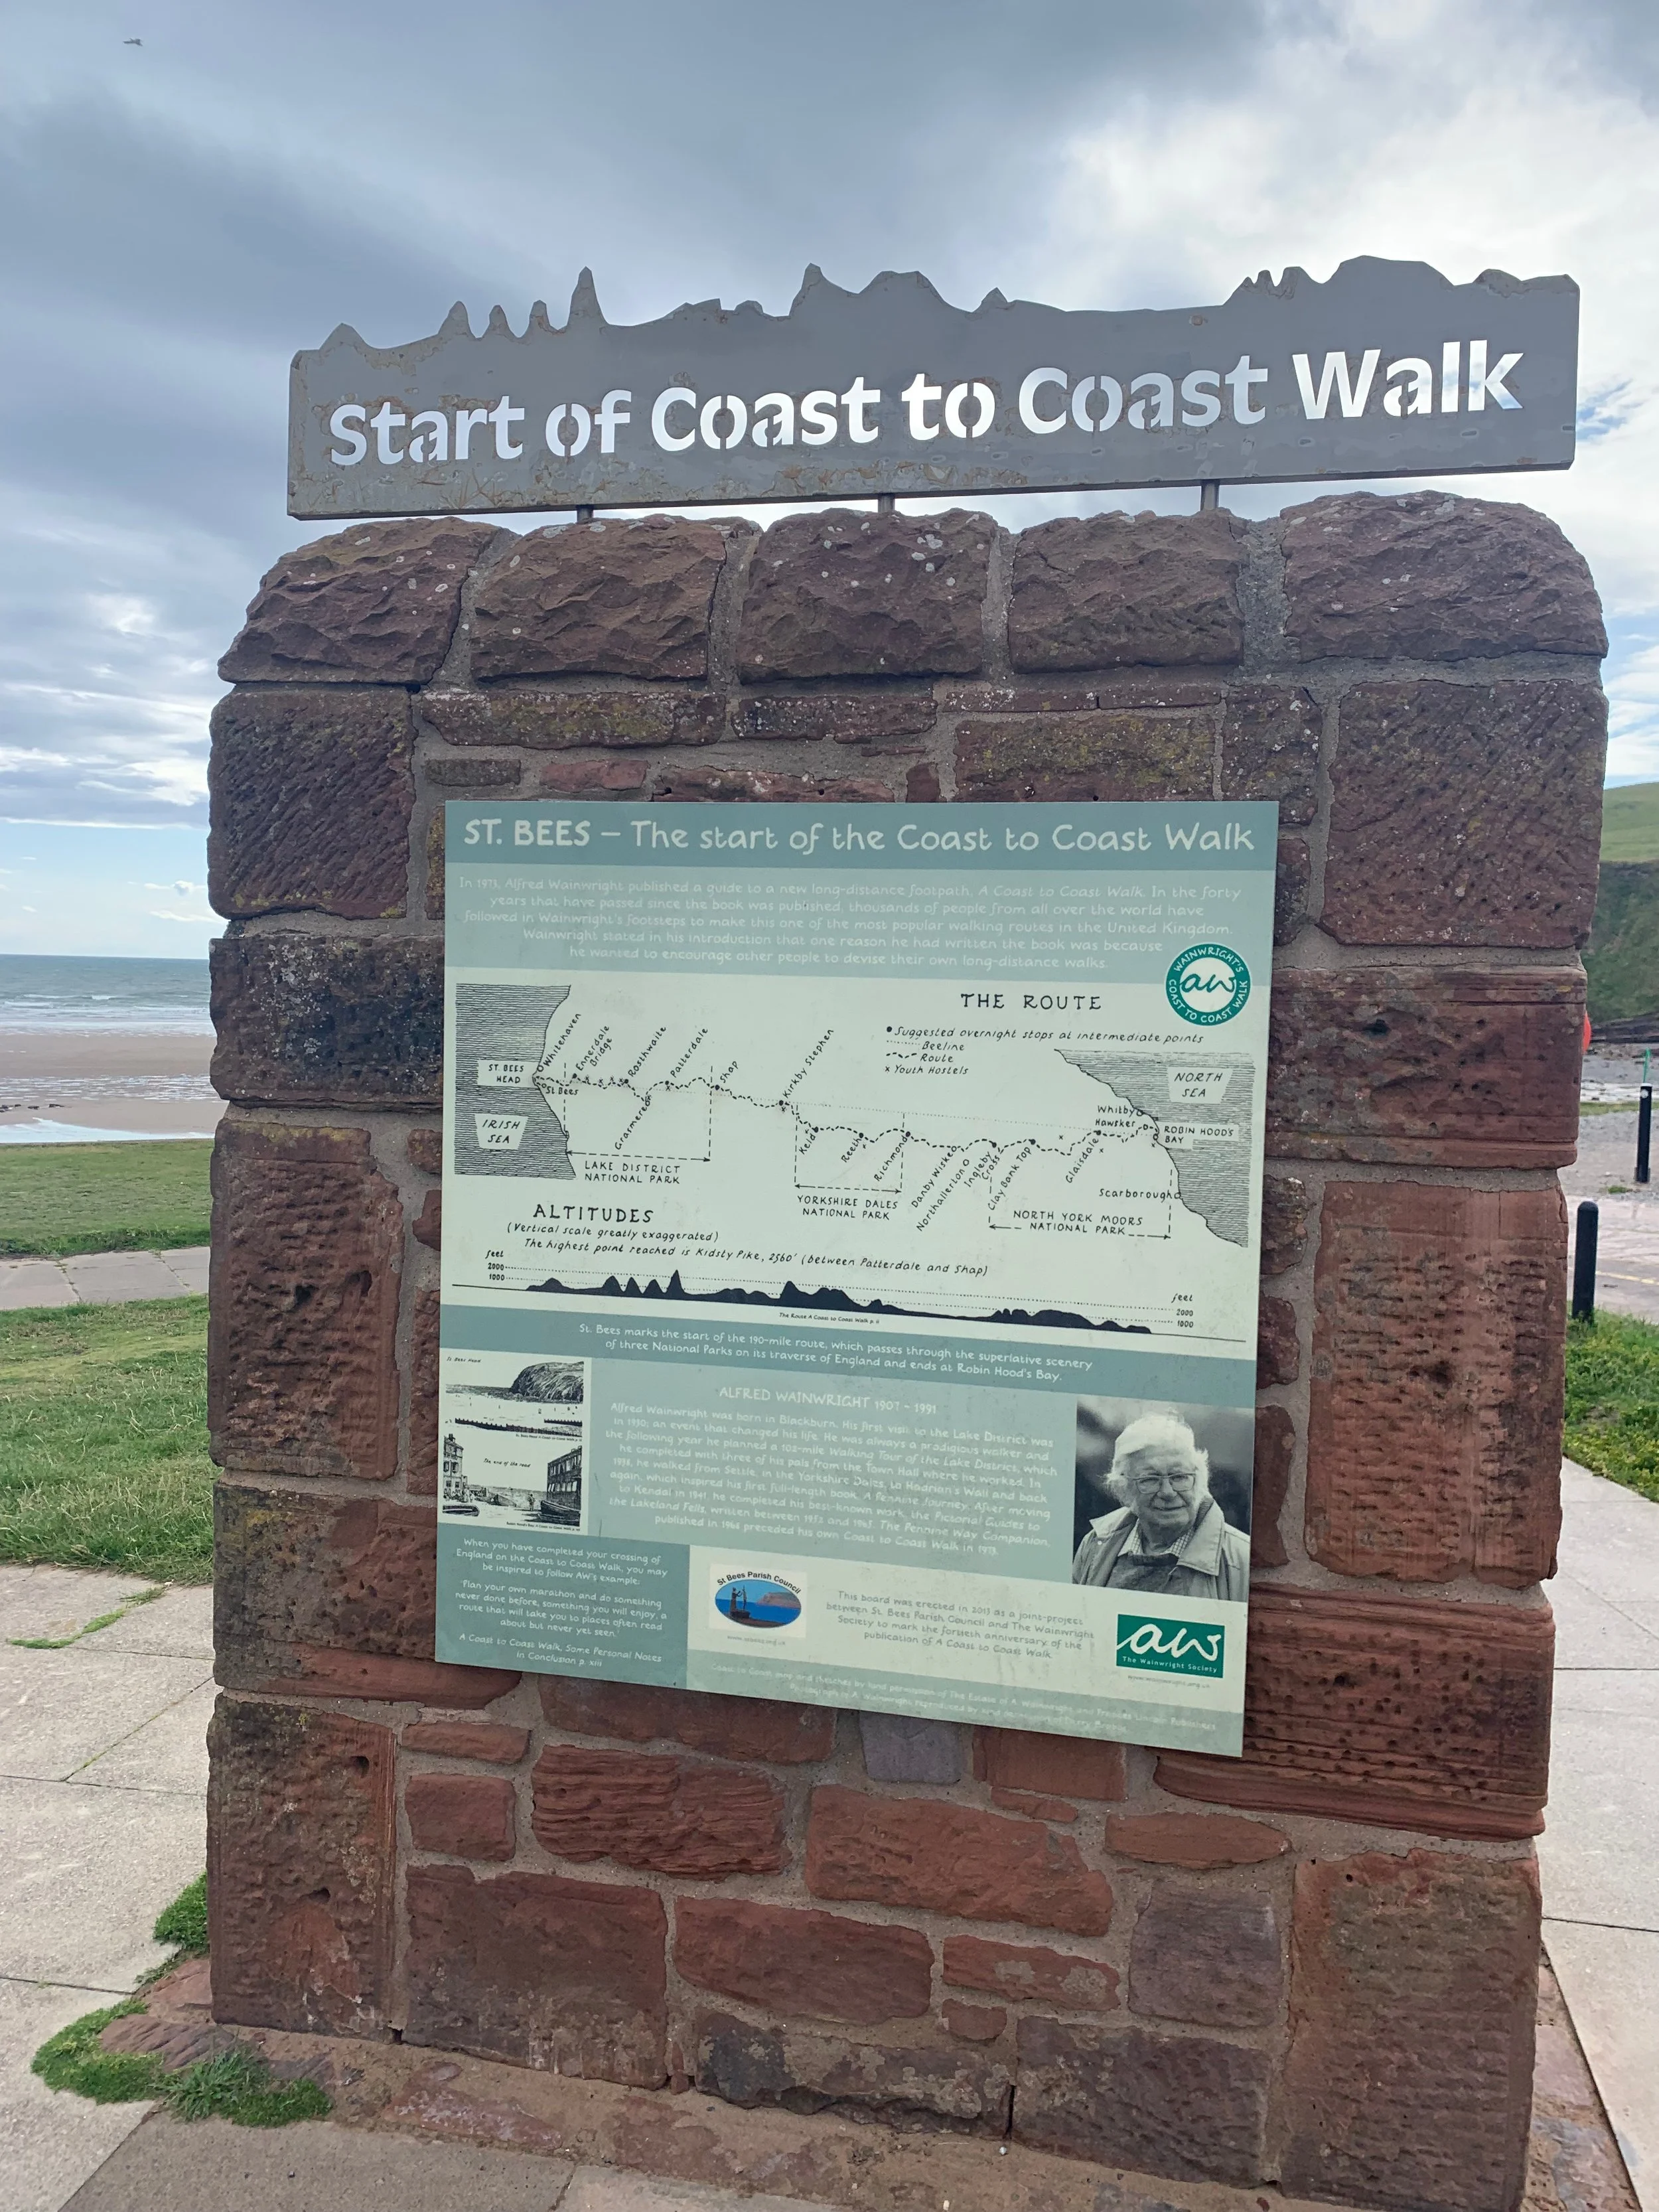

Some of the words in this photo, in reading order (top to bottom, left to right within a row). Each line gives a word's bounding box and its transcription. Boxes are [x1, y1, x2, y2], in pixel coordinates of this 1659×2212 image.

[328, 394, 526, 467] Start
[544, 389, 632, 457] of
[650, 376, 881, 451] Coast
[901, 372, 995, 441] to
[1019, 354, 1269, 436] Coast
[1293, 339, 1525, 421] Walk
[463, 818, 503, 846] ST.
[514, 820, 591, 847] BEES
[630, 820, 689, 848] The
[699, 825, 778, 850] start
[789, 823, 824, 855] of
[831, 823, 885, 850] the
[898, 823, 993, 851] Coast
[1005, 827, 1039, 851] to
[1052, 823, 1151, 851] Coast
[1165, 822, 1255, 851] Walk
[1174, 946, 1244, 972] WAINWRIGHT'S
[961, 994, 1005, 1009] THE
[1024, 995, 1102, 1010] ROUTE
[1169, 980, 1185, 1009] COAST
[1185, 1009, 1197, 1020] TO
[1200, 1007, 1232, 1023] COAST
[1232, 980, 1248, 1008] WALK
[544, 1013, 581, 1067] Whitehaven
[895, 1026, 954, 1040] Suggested
[960, 1029, 1017, 1041] overnight
[1023, 1031, 1054, 1041] stops
[1077, 1032, 1161, 1043] intermediate
[1163, 1033, 1204, 1044] points
[575, 1025, 610, 1071] Ennerdale
[590, 1037, 613, 1067] Bridge
[628, 1026, 666, 1077] Rosthwaite
[670, 1028, 708, 1078] Patterdale
[922, 1041, 964, 1051] Beeline
[488, 1064, 500, 1072] ST.
[503, 1064, 525, 1072] BEES
[782, 1067, 807, 1098] Kirkby
[806, 1029, 834, 1066] Stephen
[920, 1054, 954, 1063] Route
[720, 1061, 739, 1084] Shap
[895, 1065, 923, 1074] Youth
[928, 1066, 970, 1075] Hostels
[1174, 1072, 1224, 1082] NORTH
[545, 1086, 556, 1094] St
[558, 1086, 579, 1095] Bees
[1181, 1088, 1206, 1098] SEA
[1097, 1105, 1135, 1118] Whitby
[482, 1119, 520, 1130] IRISH
[614, 1106, 648, 1150] Grasmere
[1095, 1118, 1136, 1128] Hawsker
[1164, 1126, 1195, 1135] ROBIN
[1200, 1128, 1235, 1138] HOOD'S
[488, 1134, 510, 1143] SEA
[800, 1134, 816, 1155] Keld
[841, 1138, 861, 1163] Reeth
[874, 1136, 908, 1182] Richmond
[1066, 1138, 1099, 1184] Glaisdale
[585, 1161, 613, 1171] LAKE
[623, 1162, 680, 1173] DISTRICT
[964, 1151, 994, 1188] Ingleby
[981, 1153, 1001, 1180] Cross
[585, 1173, 642, 1183] NATIONAL
[649, 1175, 680, 1184] PARK
[911, 1179, 934, 1208] Danby
[932, 1151, 954, 1179] Wiske
[987, 1187, 1005, 1211] Clay
[999, 1163, 1019, 1192] Bank
[1015, 1146, 1032, 1168] Top
[797, 1195, 858, 1207] YORKSHIRE
[865, 1198, 898, 1209] DALES
[916, 1166, 964, 1232] Northallerton
[1099, 1188, 1173, 1200] Scarborough
[533, 1205, 654, 1223] ALTITUDES
[802, 1208, 855, 1218] NATIONAL
[862, 1210, 890, 1220] PARK
[1013, 1210, 1054, 1220] NORTH
[1062, 1213, 1092, 1222] YORK
[1102, 1215, 1143, 1226] MOORS
[506, 1222, 559, 1236] (Vertical
[563, 1225, 593, 1236] scale
[597, 1228, 638, 1240] greatly
[641, 1230, 719, 1244] exaggerated)
[1030, 1222, 1088, 1234] NATIONAL
[1096, 1224, 1126, 1236] PARK
[485, 1250, 504, 1260] feet
[524, 1238, 544, 1249] The
[545, 1240, 590, 1253] highest
[594, 1244, 625, 1256] point
[630, 1246, 676, 1256] reached
[681, 1248, 689, 1257] is
[695, 1248, 733, 1260] Kidsty
[735, 1250, 764, 1262] Pike,
[801, 1254, 855, 1268] (between
[860, 1258, 921, 1270] Patterdale
[926, 1264, 950, 1273] and
[953, 1264, 988, 1278] Shap)
[1177, 1319, 1192, 1328] 1000
[579, 1323, 592, 1334] St.
[596, 1324, 621, 1335] Bees
[624, 1327, 658, 1338] marks
[662, 1329, 680, 1339] the
[682, 1331, 710, 1341] start
[713, 1331, 725, 1343] of
[727, 1333, 746, 1343] the
[749, 1335, 792, 1346] 190-mile
[796, 1338, 828, 1349] route,
[831, 1340, 863, 1352] which
[867, 1344, 902, 1355] passes
[906, 1345, 952, 1361] through
[955, 1349, 975, 1360] the
[978, 1351, 1042, 1365] superlative
[1045, 1357, 1093, 1371] scenery
[605, 1339, 617, 1351] of
[620, 1340, 648, 1351] three
[652, 1341, 699, 1354] National
[703, 1345, 733, 1356] Parks
[736, 1349, 749, 1357] on
[753, 1349, 766, 1359] its
[769, 1351, 817, 1362] traverse
[820, 1353, 832, 1364] of
[835, 1354, 881, 1368] England
[883, 1357, 906, 1368] and
[910, 1360, 937, 1371] ends
[940, 1363, 954, 1372] at
[957, 1363, 991, 1375] Robin
[995, 1366, 1032, 1378] Hood's
[1036, 1370, 1062, 1383] Bay.
[719, 1386, 771, 1401] ALFRED
[775, 1391, 871, 1408] WAINWRIGHT
[874, 1400, 900, 1411] 1907
[913, 1402, 937, 1415] 1991
[463, 1538, 489, 1548] When
[491, 1542, 509, 1554] you
[511, 1542, 534, 1552] have
[536, 1546, 583, 1557] completed
[587, 1550, 607, 1560] your
[610, 1550, 648, 1566] crossing
[651, 1554, 662, 1565] of
[774, 1576, 802, 1594] Council
[1140, 1659, 1185, 1669] Wainwright
[1188, 1664, 1217, 1672] Society
